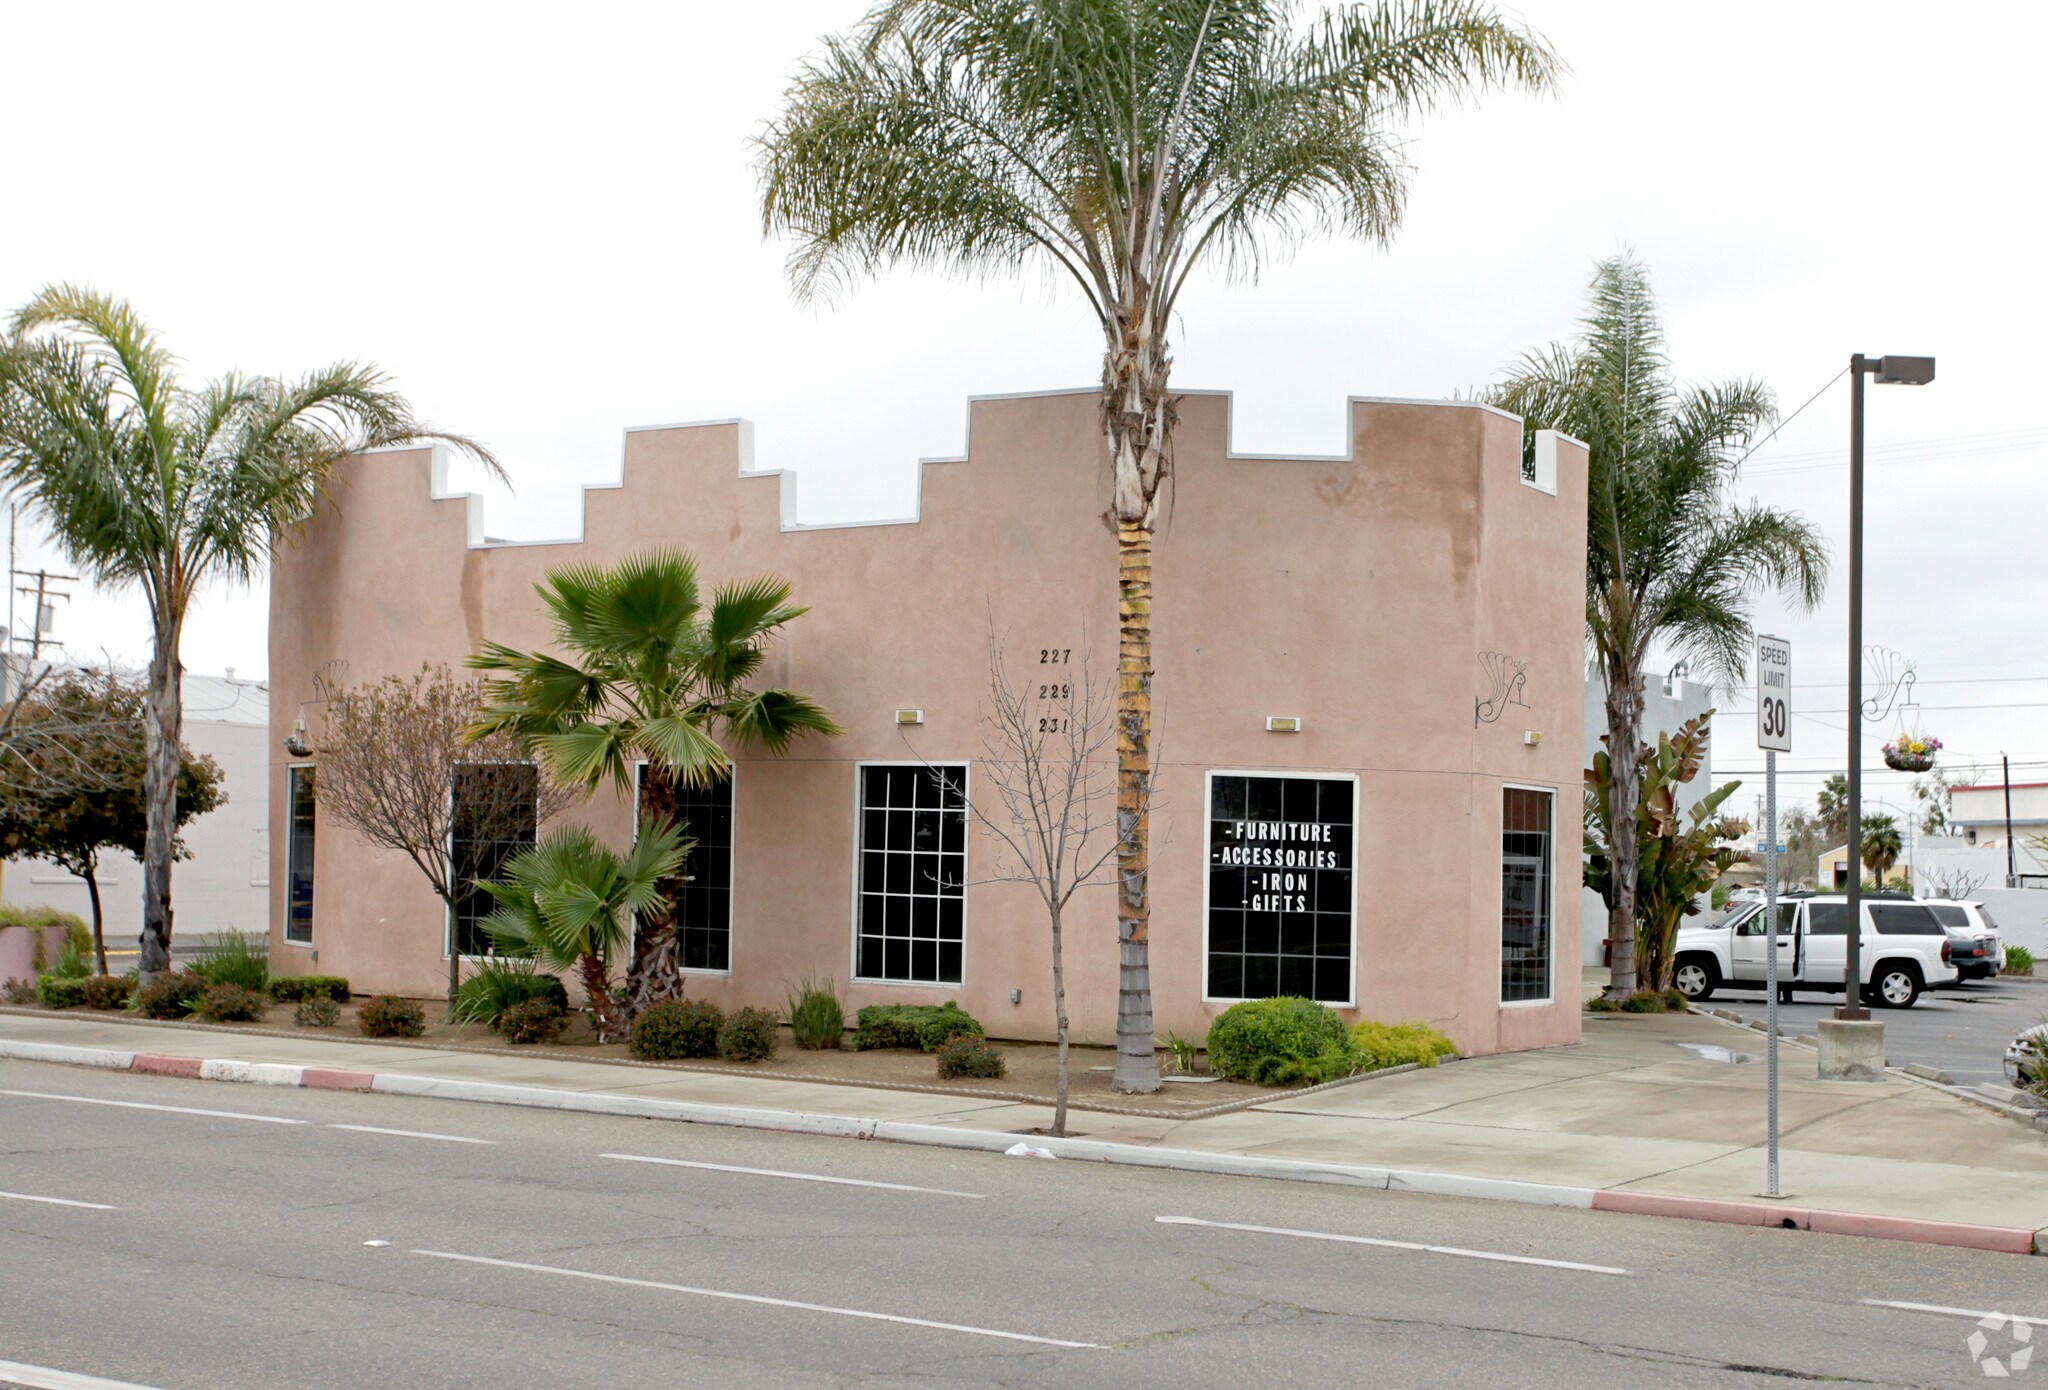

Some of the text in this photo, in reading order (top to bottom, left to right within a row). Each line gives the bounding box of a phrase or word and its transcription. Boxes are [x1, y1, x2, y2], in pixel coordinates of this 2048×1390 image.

[1040, 649, 1071, 664] 227
[1760, 646, 1788, 666] SPEED
[1763, 669, 1785, 688] LIMIT
[1039, 684, 1070, 699] 229
[1039, 718, 1068, 733] 231
[1763, 696, 1786, 738] 30
